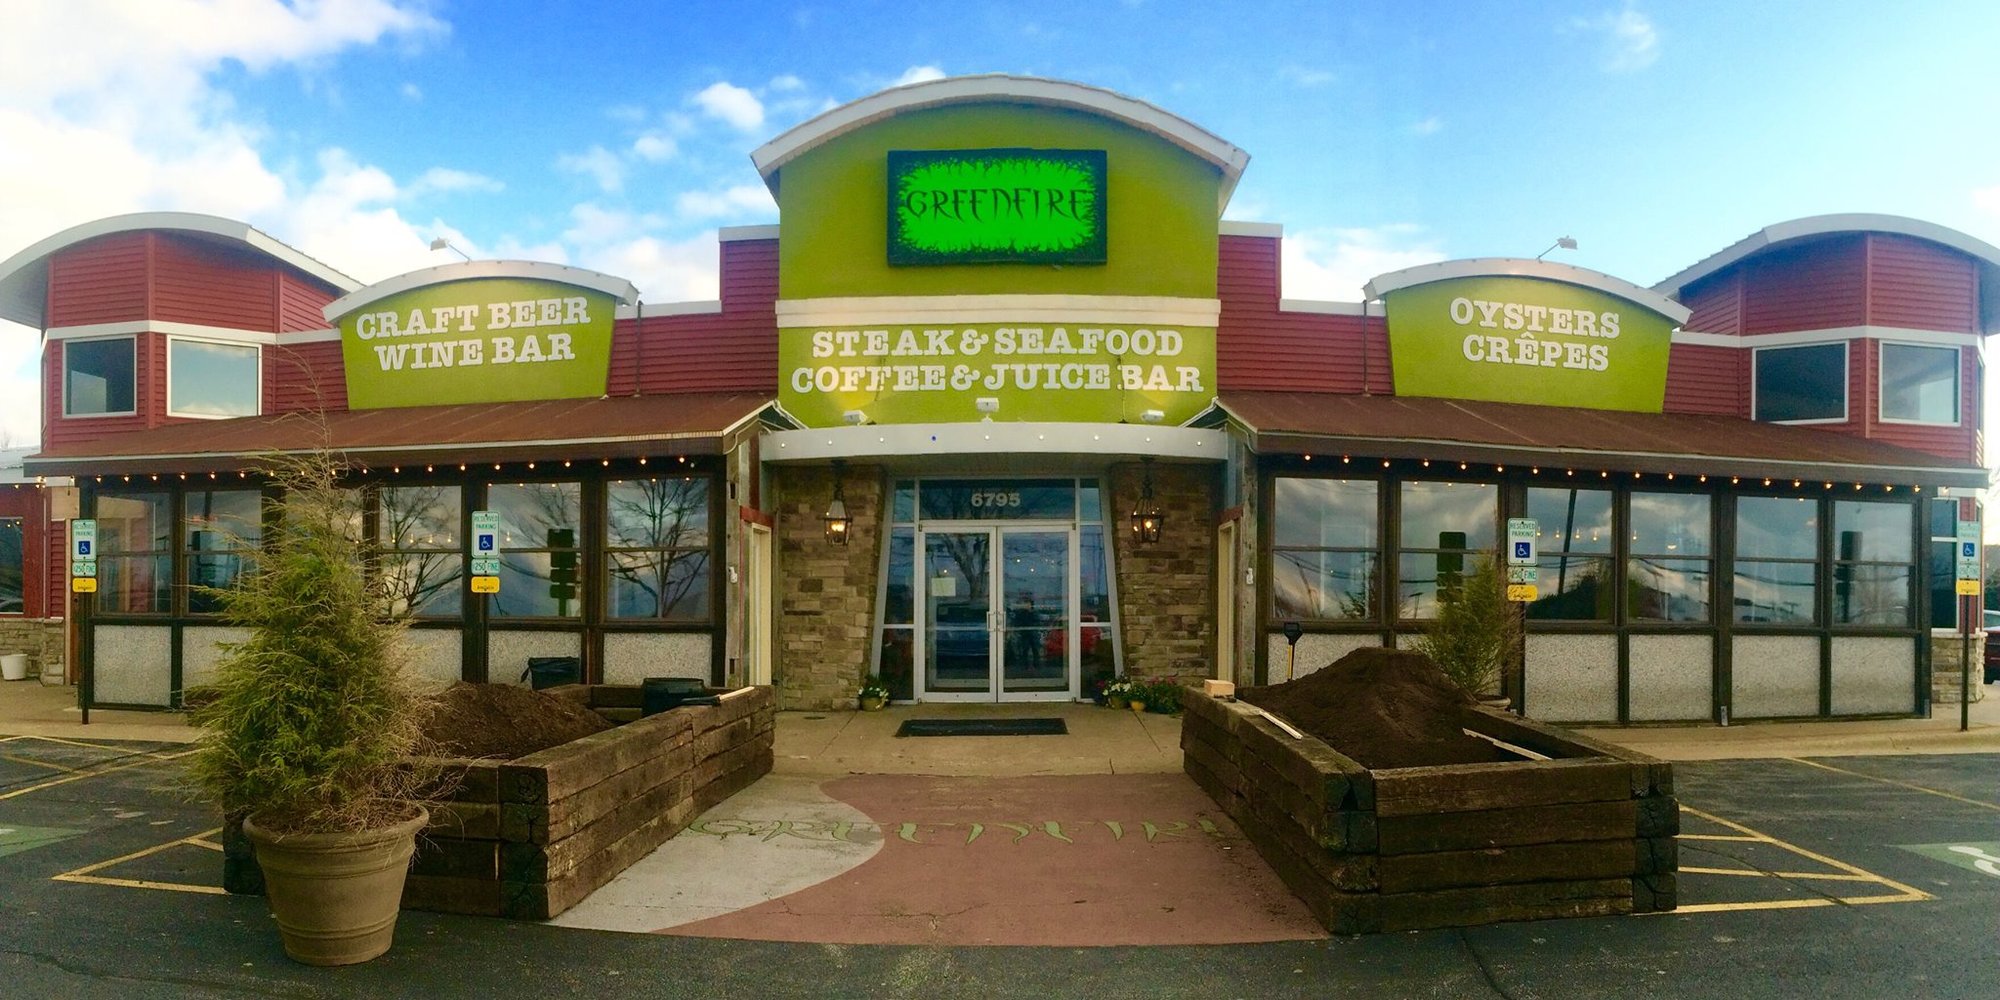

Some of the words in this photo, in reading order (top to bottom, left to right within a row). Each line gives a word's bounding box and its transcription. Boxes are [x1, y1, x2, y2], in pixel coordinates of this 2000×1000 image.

[906, 188, 1091, 223] GREENFIRE
[356, 304, 480, 340] CRAFT
[487, 297, 591, 330] BEER
[1450, 297, 1620, 339] OYSTERS
[374, 338, 483, 371] WINE
[491, 333, 575, 364] BAR
[812, 330, 955, 357] STEAK
[994, 328, 1183, 356] SEAFOOD
[1462, 331, 1609, 371] CRÊPES
[791, 366, 946, 393] COFFEE
[983, 363, 1111, 390] JUICE
[1117, 365, 1204, 392] BAR
[971, 492, 1021, 508] 6795
[1511, 530, 1534, 538] PARKING
[1524, 570, 1537, 580] FINE
